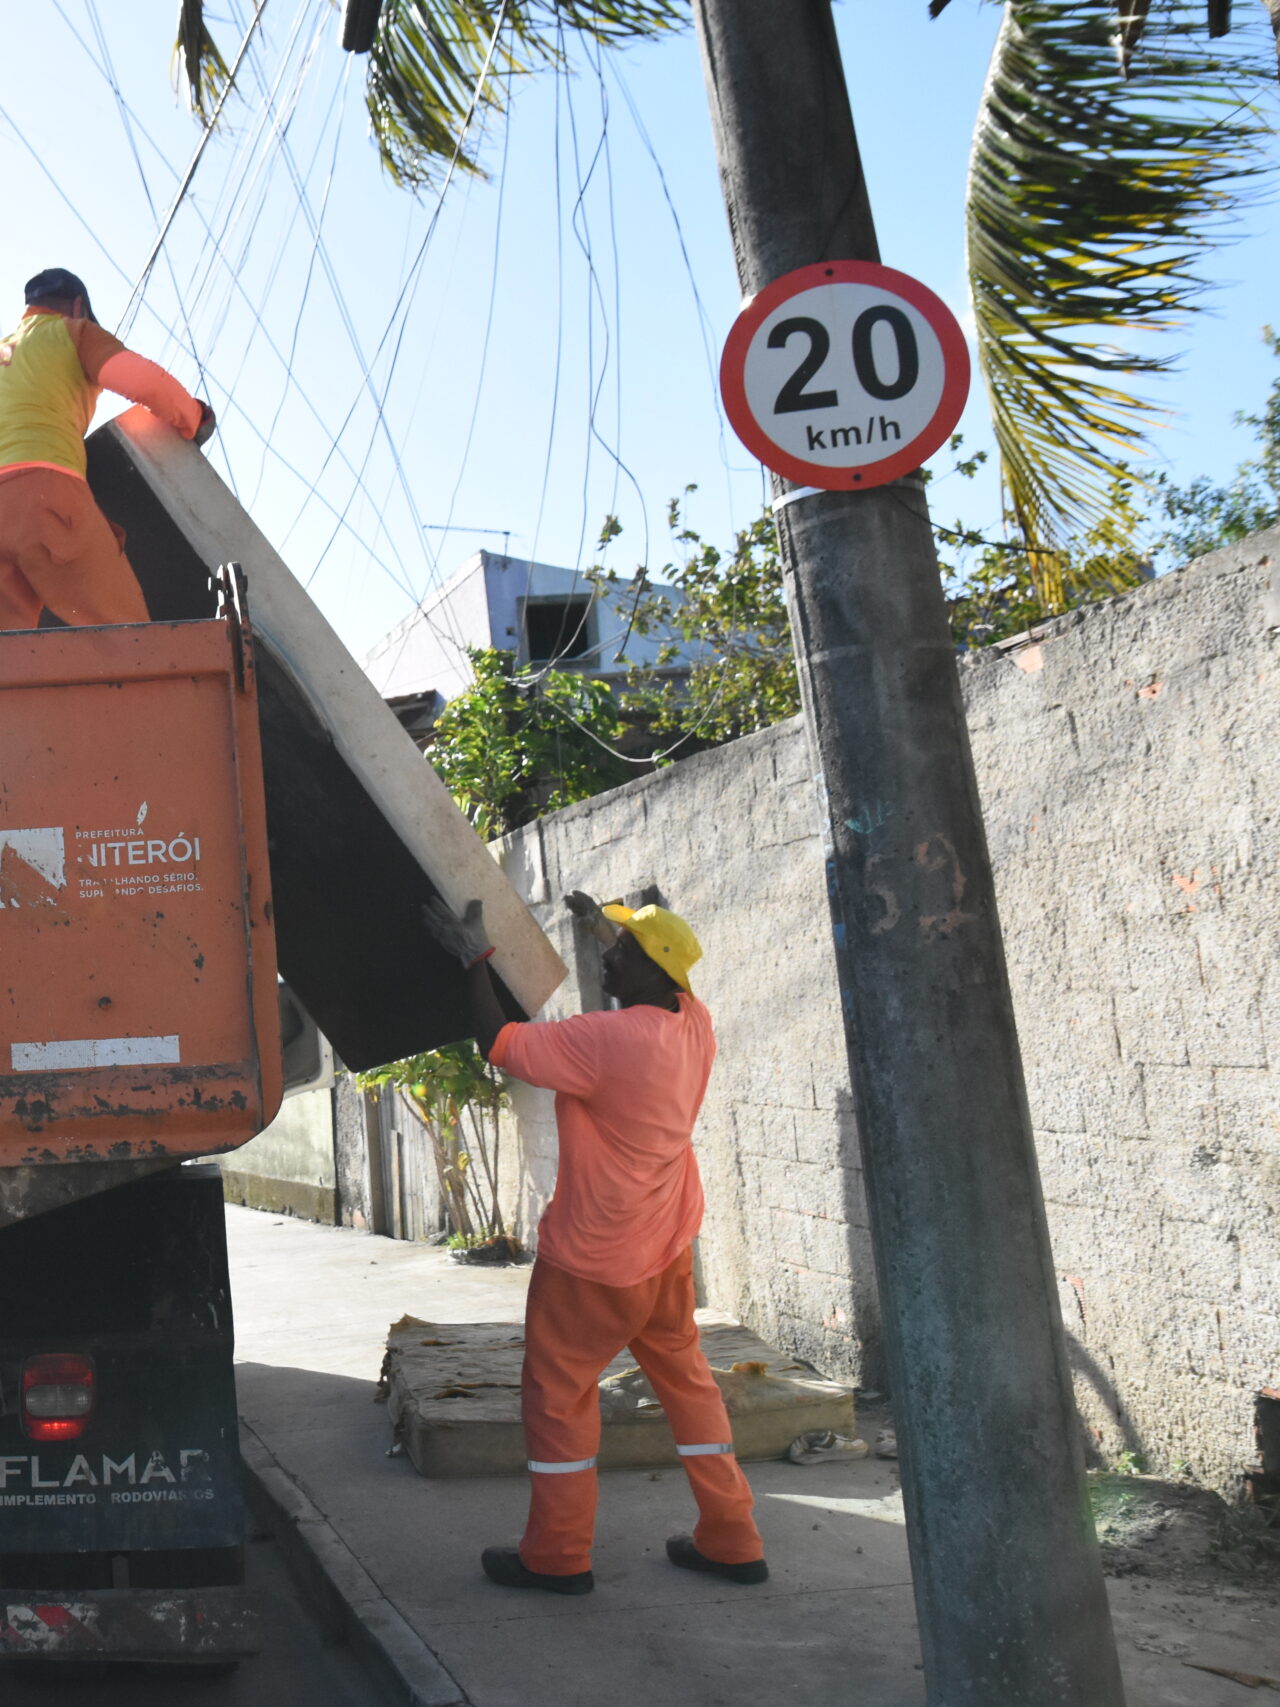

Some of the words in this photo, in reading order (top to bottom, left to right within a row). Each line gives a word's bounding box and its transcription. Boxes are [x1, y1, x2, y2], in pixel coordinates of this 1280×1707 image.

[767, 305, 919, 415] 20
[806, 416, 902, 451] km/h
[75, 828, 144, 839] PREFEITURA
[79, 874, 160, 887] TRALHANDO
